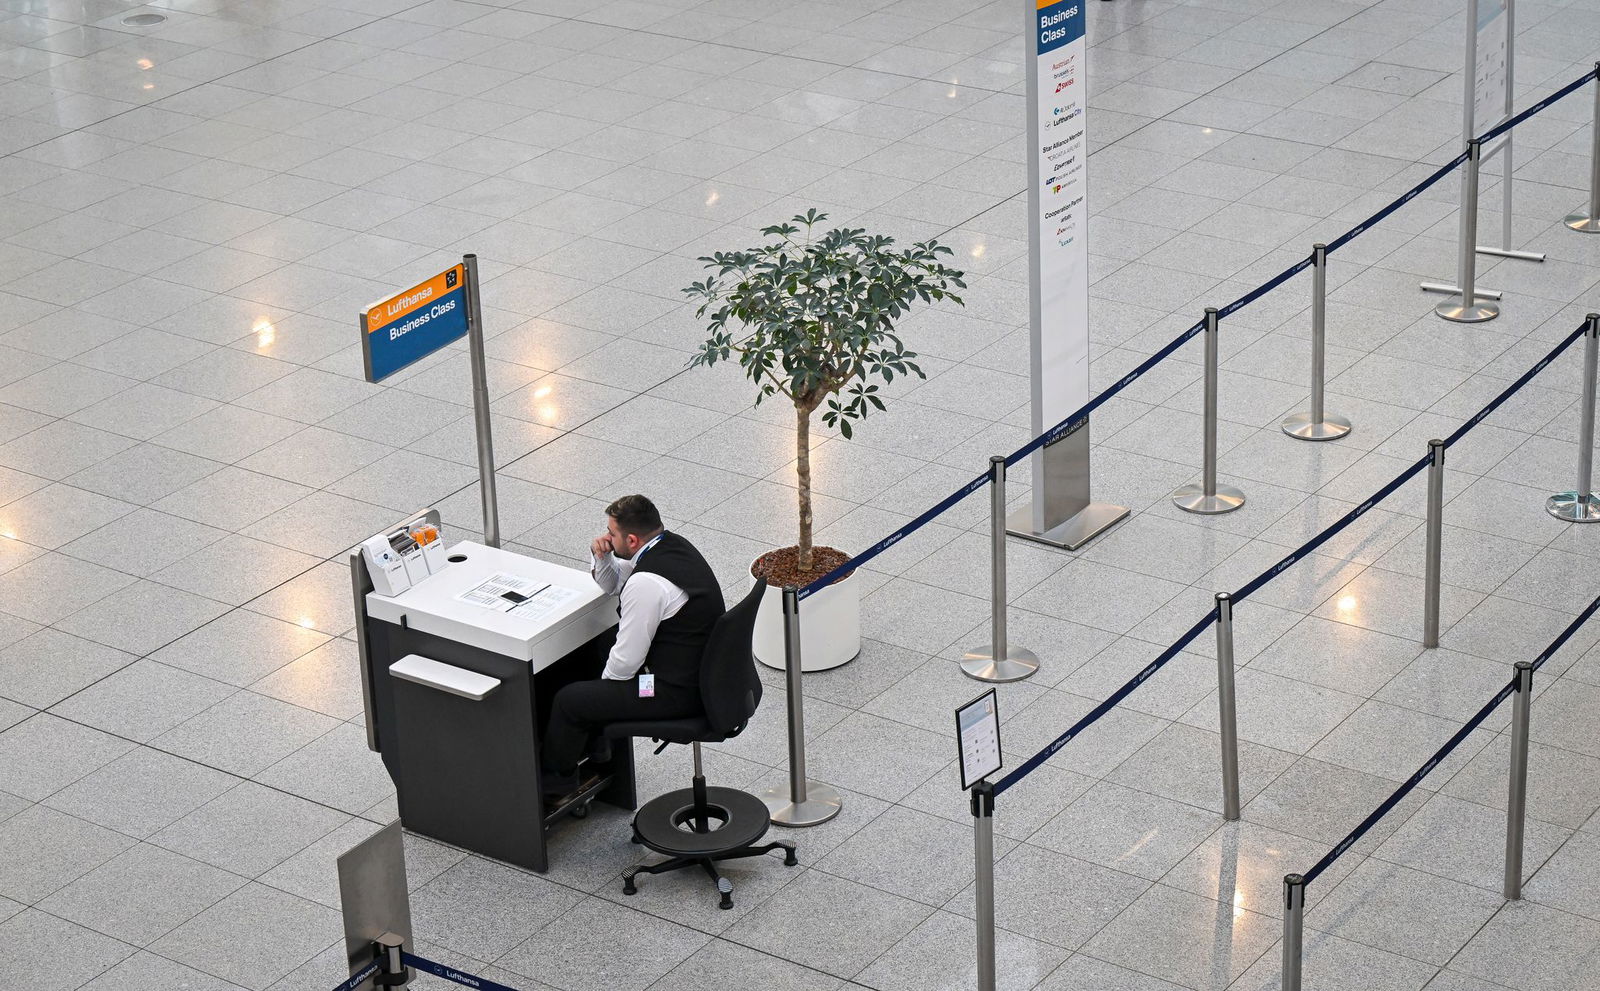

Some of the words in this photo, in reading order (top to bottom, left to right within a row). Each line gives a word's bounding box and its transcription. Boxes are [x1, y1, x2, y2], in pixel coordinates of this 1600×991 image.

[1041, 5, 1078, 28] Business
[1041, 27, 1066, 44] Class
[1053, 113, 1074, 127] Lufthansa
[1042, 145, 1052, 154] Star
[1052, 138, 1069, 150] Alliance
[387, 287, 433, 316] Lufthansa
[389, 314, 430, 340] Business
[431, 299, 456, 318] Class
[883, 533, 903, 547] Lufthansa
[1277, 557, 1295, 571] Lufthansa
[1139, 664, 1156, 681] Lufthansa
[1051, 735, 1071, 751] Lufthansa
[349, 965, 378, 988] Lufthansa
[446, 970, 480, 987] Lufthansa
